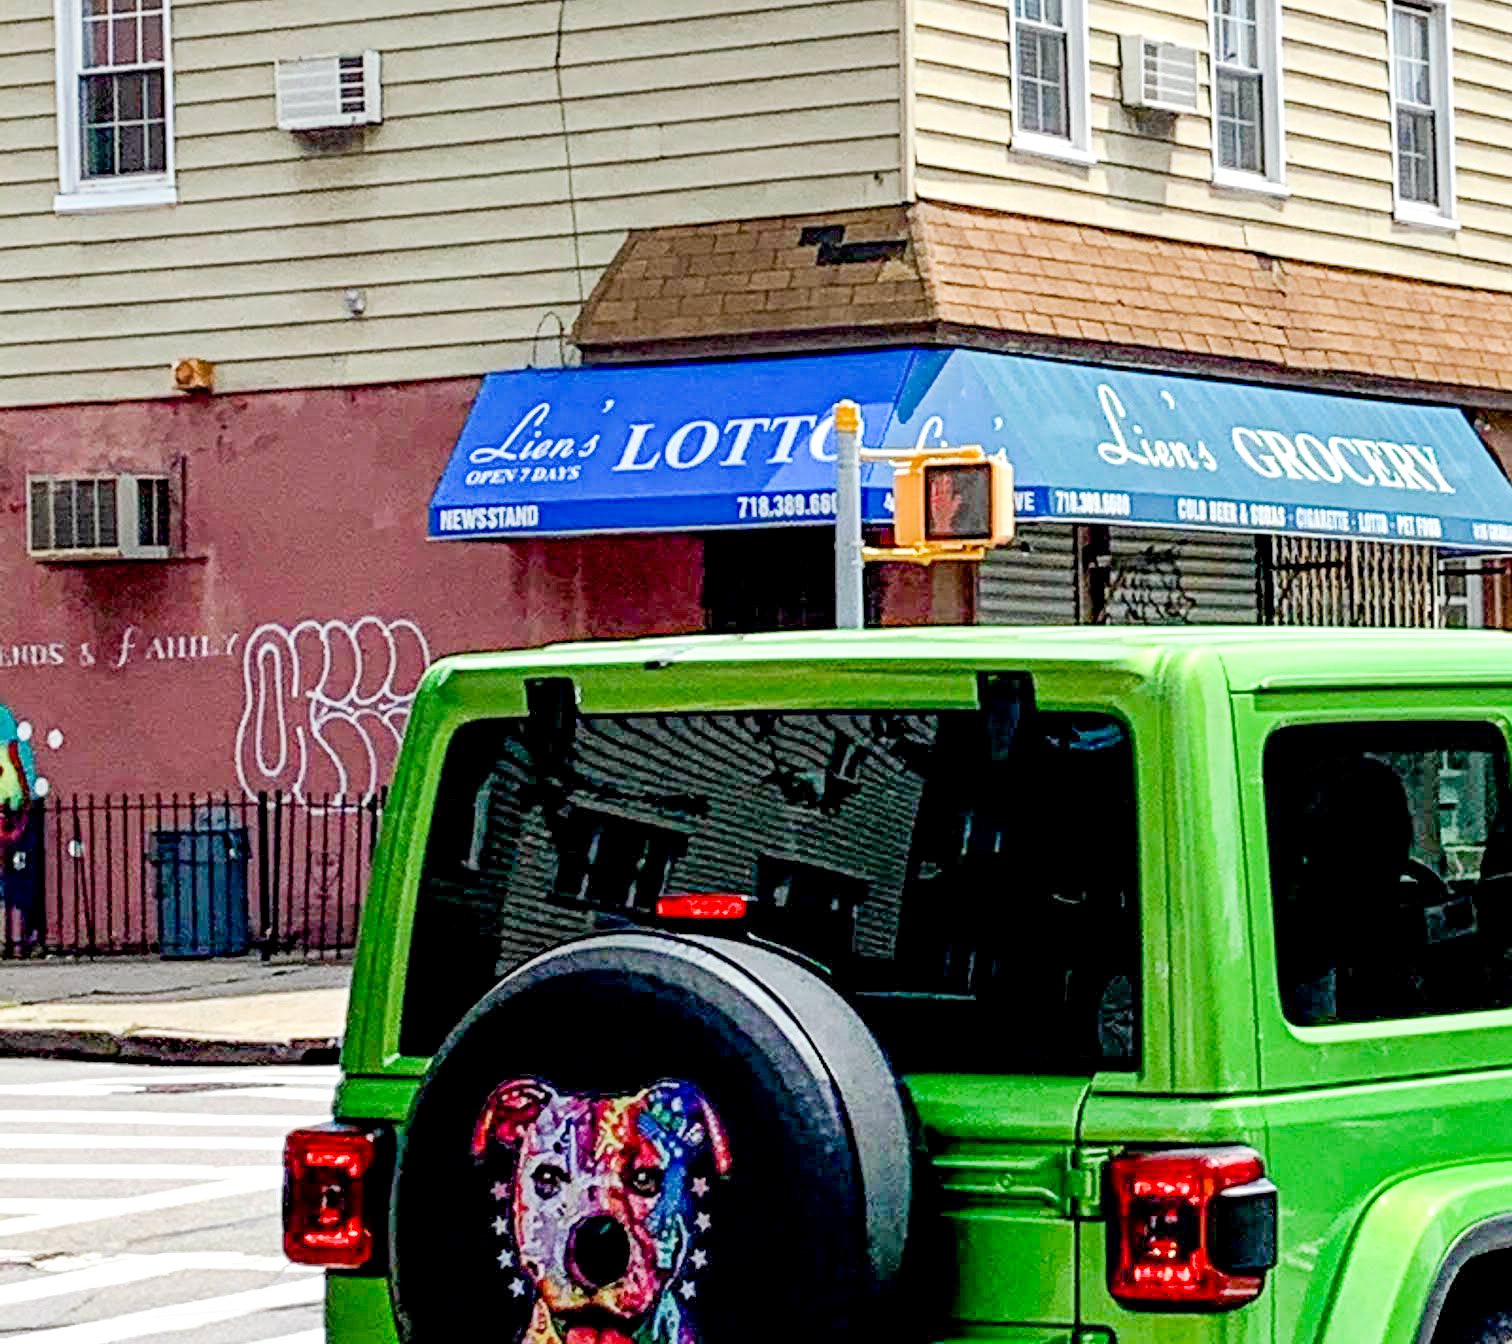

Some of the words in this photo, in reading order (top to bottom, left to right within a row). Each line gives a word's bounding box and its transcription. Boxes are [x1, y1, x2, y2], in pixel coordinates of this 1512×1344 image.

[1231, 426, 1456, 494] GROCERY
[465, 468, 519, 486] OPEN
[519, 468, 531, 483] 7
[530, 465, 581, 483] DAYS
[439, 505, 539, 531] NEWSSTAND
[1177, 497, 1207, 522] COLD
[1209, 500, 1238, 524] BEER
